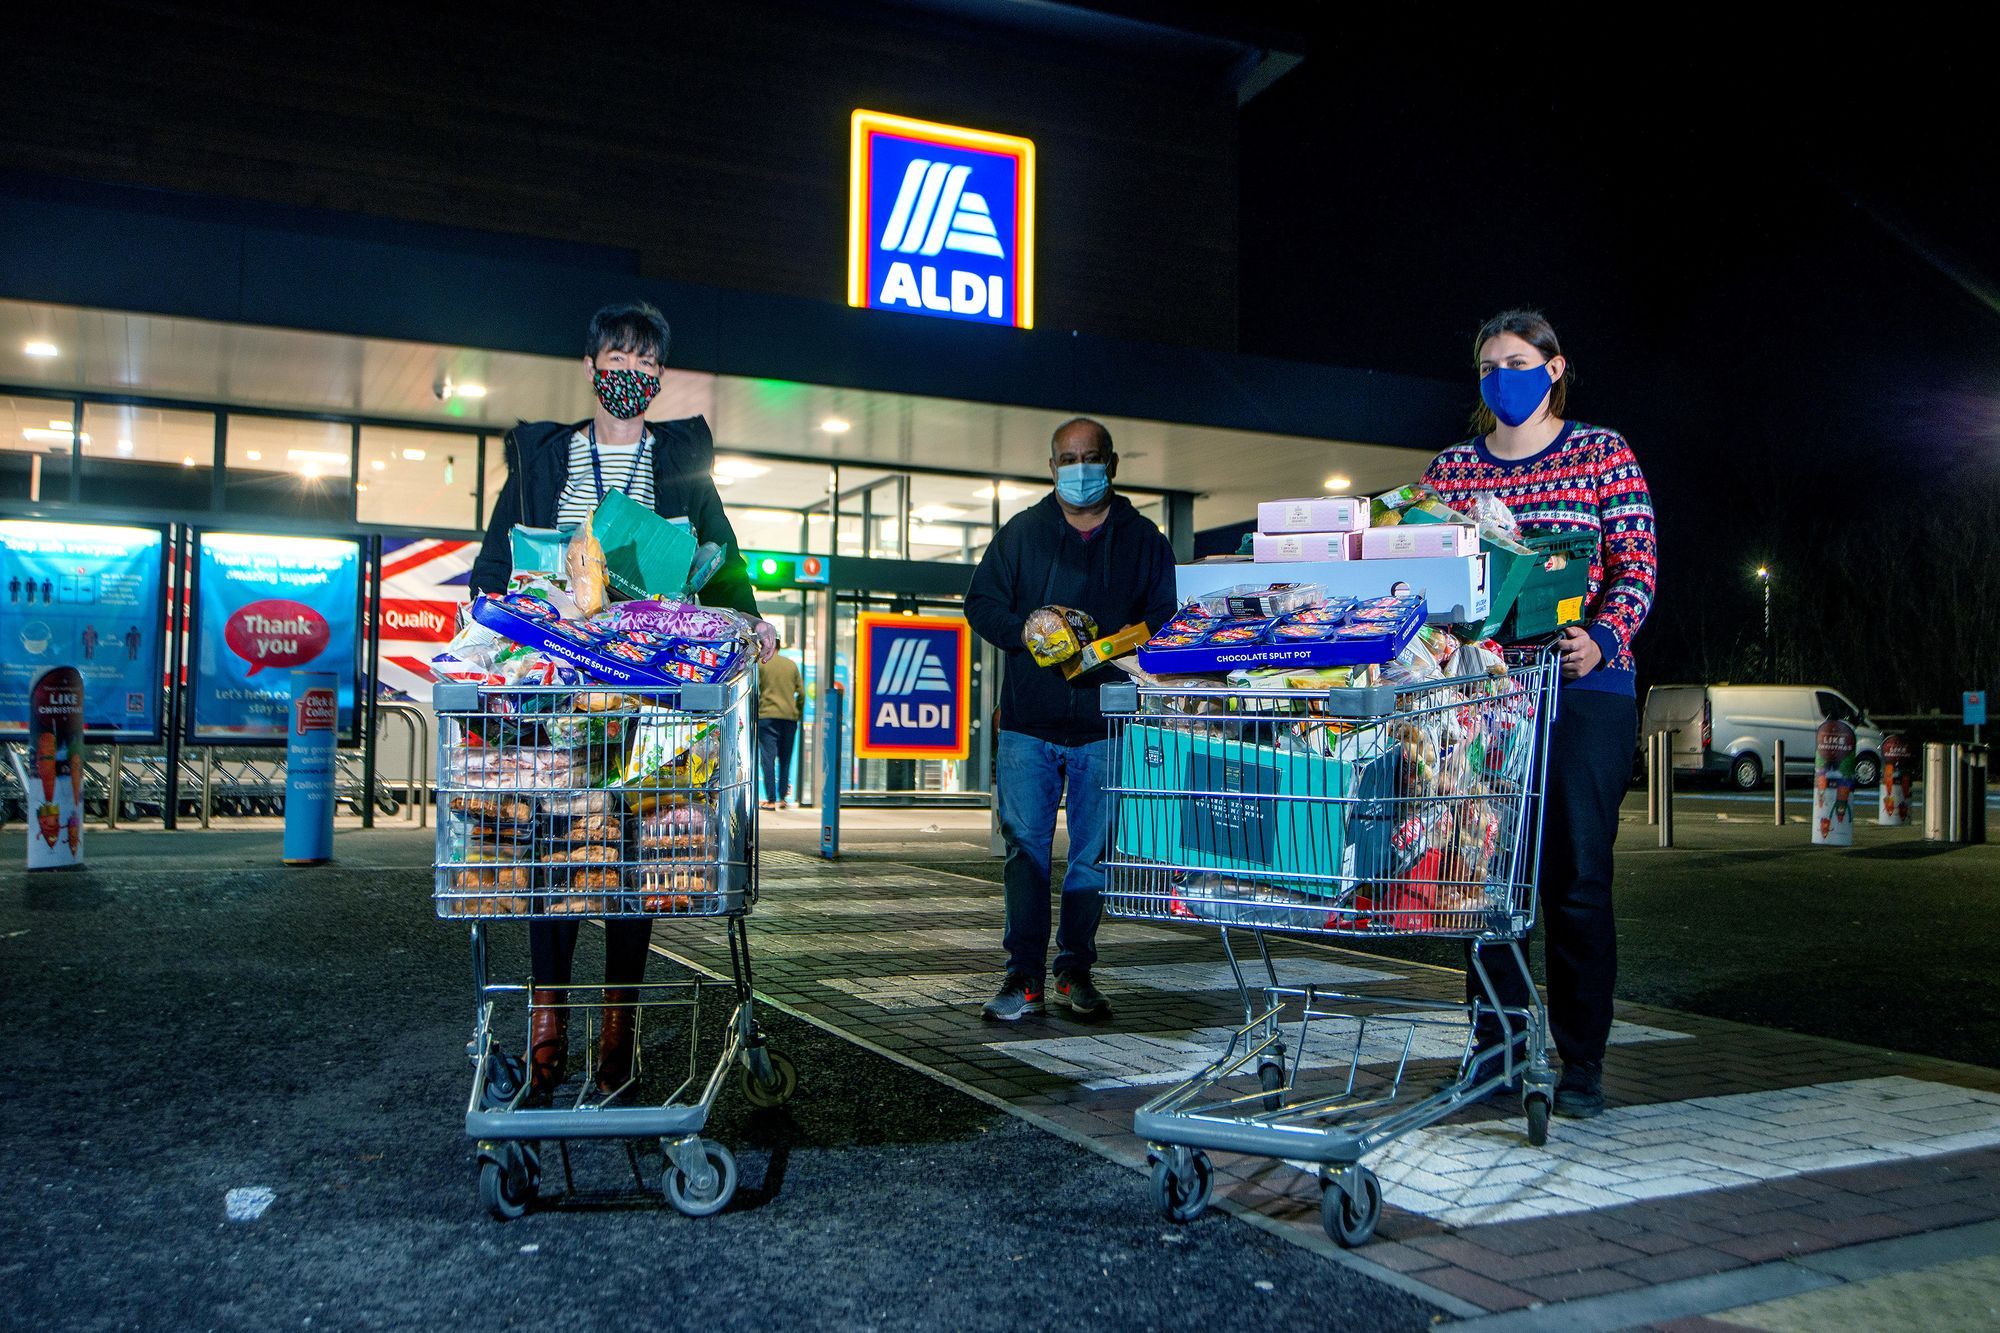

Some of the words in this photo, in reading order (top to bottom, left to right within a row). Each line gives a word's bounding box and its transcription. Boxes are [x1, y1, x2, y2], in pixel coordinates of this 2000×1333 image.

[879, 261, 1003, 318] ALDI
[244, 615, 312, 635] Thank
[385, 609, 446, 633] Quality
[257, 638, 298, 658] you
[543, 639, 591, 666] CHOCOLATE
[591, 660, 613, 676] SPLIT
[613, 669, 631, 681] POT
[1216, 652, 1268, 663] CHOCOLATE
[1269, 651, 1292, 660] SPLIT
[1294, 650, 1312, 659] POT
[49, 693, 78, 705] LIKE
[215, 689, 242, 700] Let's
[244, 689, 272, 702] help
[273, 690, 291, 700] ea
[306, 696, 328, 707] Click
[248, 704, 273, 714] stay
[275, 705, 288, 714] sa
[876, 702, 951, 729] ALDI
[1823, 736, 1846, 744] LIKE
